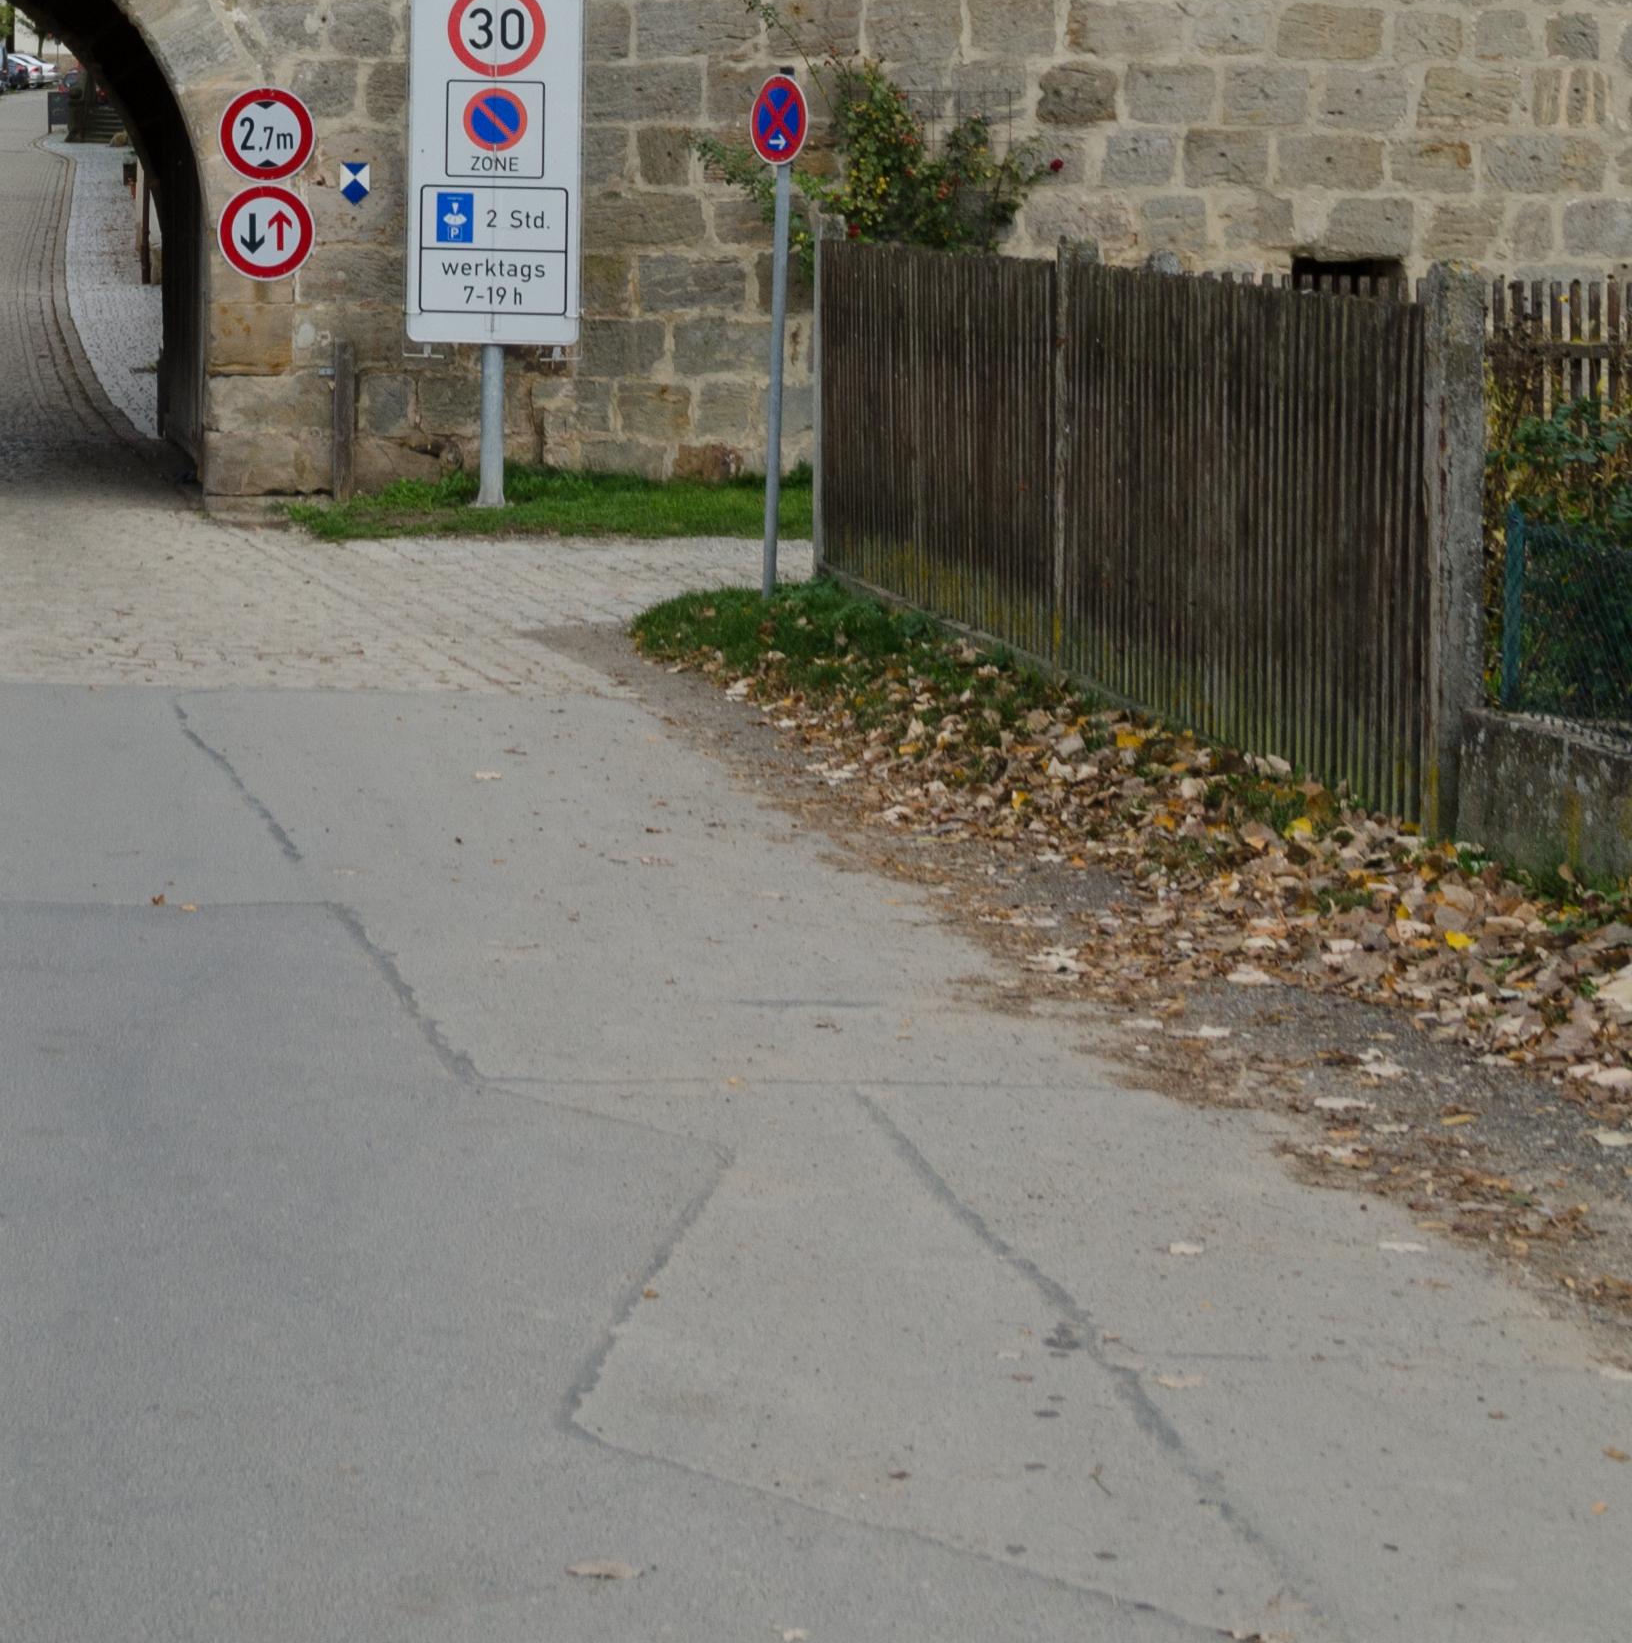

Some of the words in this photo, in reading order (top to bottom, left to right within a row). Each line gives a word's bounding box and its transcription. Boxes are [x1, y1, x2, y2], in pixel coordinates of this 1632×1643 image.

[469, 7, 525, 50] 30
[470, 156, 520, 172] ZONE
[486, 209, 497, 228] 2
[510, 210, 550, 229] Std.
[450, 226, 460, 240] P
[441, 258, 546, 282] werktags
[463, 285, 507, 305] 7-19
[514, 287, 522, 305] h
